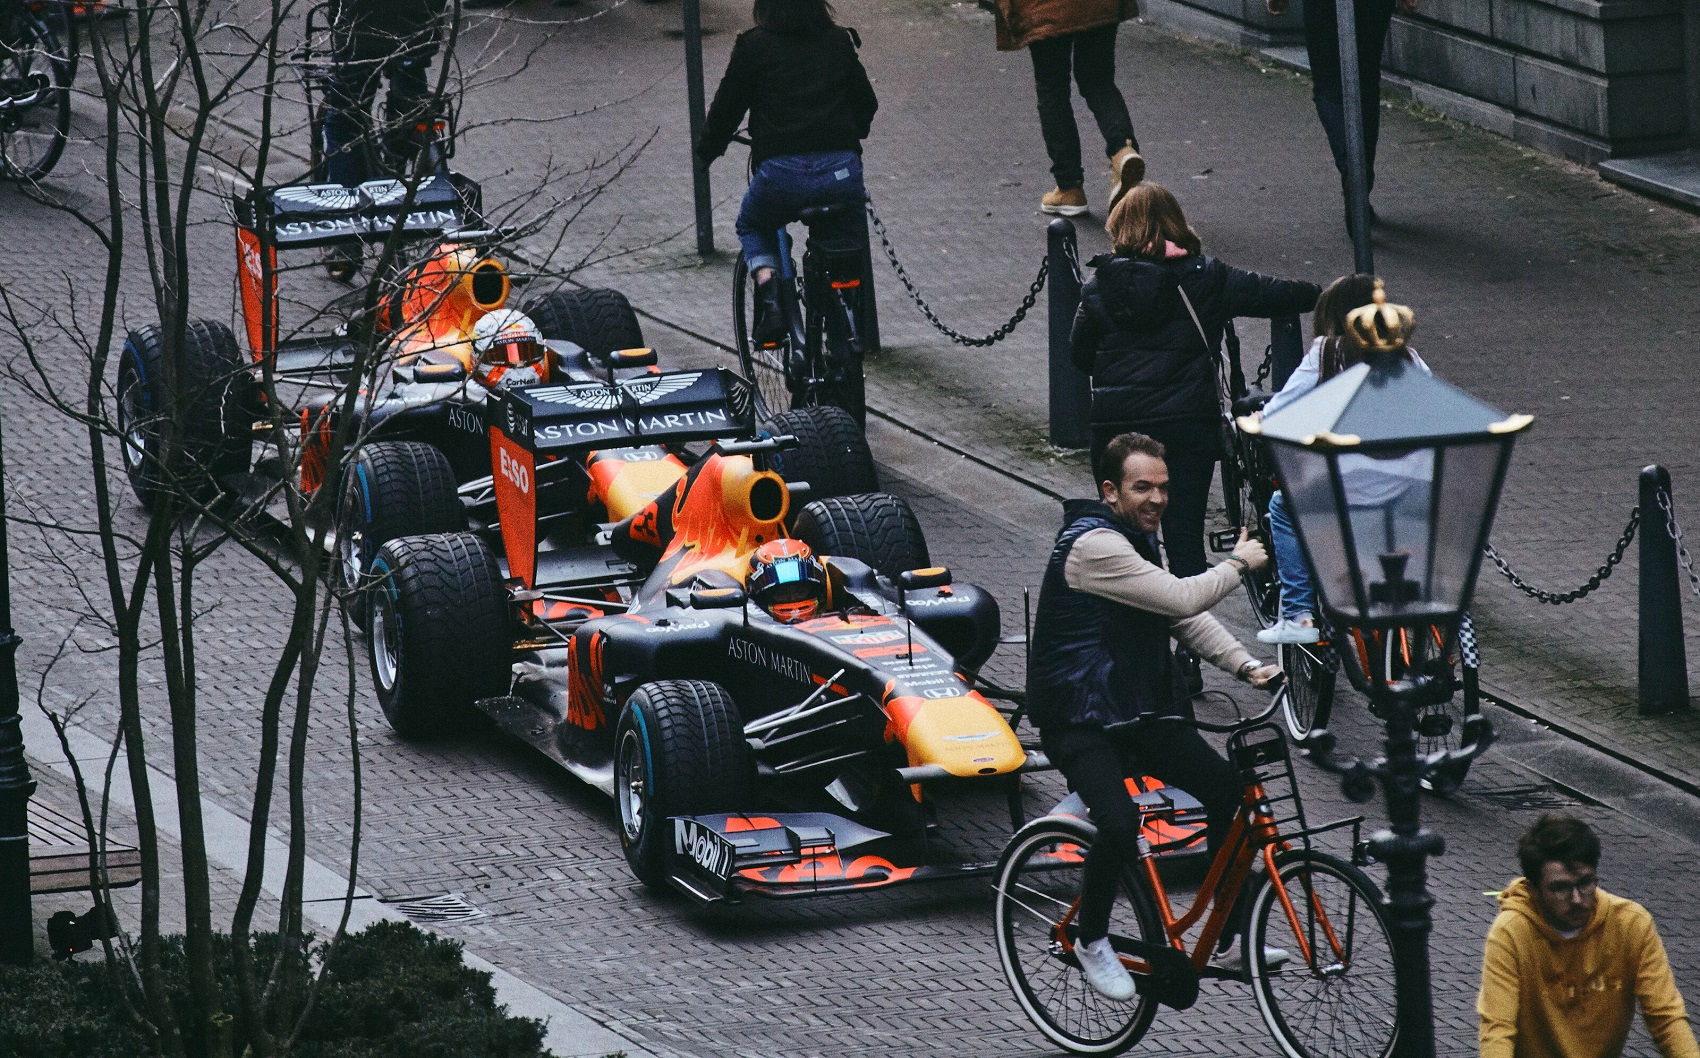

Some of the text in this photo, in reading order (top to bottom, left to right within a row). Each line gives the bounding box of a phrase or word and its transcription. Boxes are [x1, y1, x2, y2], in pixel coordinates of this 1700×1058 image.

[320, 189, 350, 198] ASTON
[579, 387, 611, 398] ASTON
[448, 407, 484, 435] ASTON
[624, 408, 727, 430] MARTIN
[728, 636, 812, 685] ASTON MARTIN
[675, 819, 720, 873] Mobil
